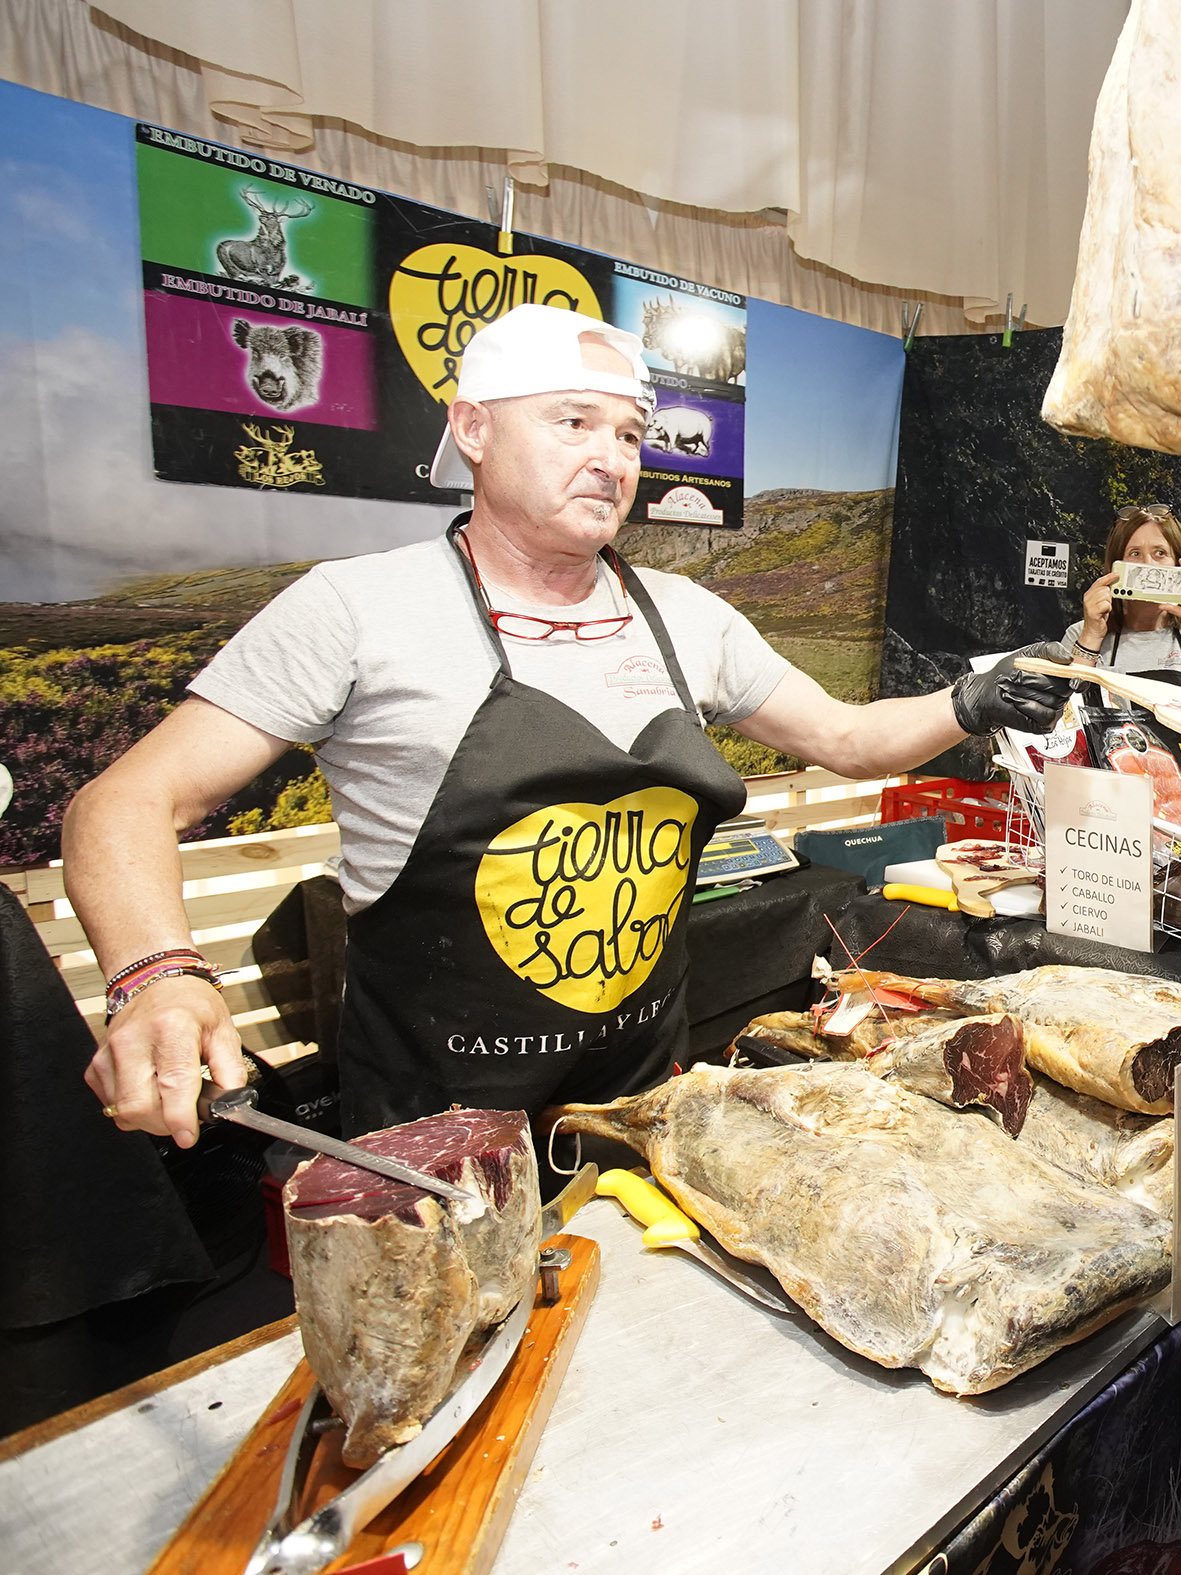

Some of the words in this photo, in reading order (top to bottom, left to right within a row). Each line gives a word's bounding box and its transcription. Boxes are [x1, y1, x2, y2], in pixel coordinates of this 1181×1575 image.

[150, 126, 266, 173] EMBUTIDO
[269, 163, 297, 182] DE
[299, 171, 377, 204] VENADO
[614, 261, 679, 288] EMBUTIDO
[679, 280, 696, 293] DE
[695, 284, 741, 305] VACUNO
[161, 273, 276, 308] EMBUTIDO
[278, 298, 305, 315] DE
[306, 303, 368, 327] JABALÍ
[649, 373, 688, 389] UTIDO
[639, 470, 680, 482] BUTIDOS
[681, 474, 732, 488] ARTESANOS
[1029, 557, 1067, 570] ACEPTAMOS
[623, 686, 677, 699] Sanabria
[485, 809, 690, 885] tierra
[845, 835, 883, 847] QUECHUA
[1065, 827, 1142, 858] CECINAS
[1072, 868, 1098, 883] TORO
[1101, 874, 1114, 887] DE
[1116, 878, 1142, 893] LIDIA
[1072, 886, 1115, 905] CABALLO
[504, 883, 585, 930] de
[1072, 904, 1108, 921] CIERVO
[1073, 922, 1104, 937] JABALI
[616, 1013, 631, 1031] Y
